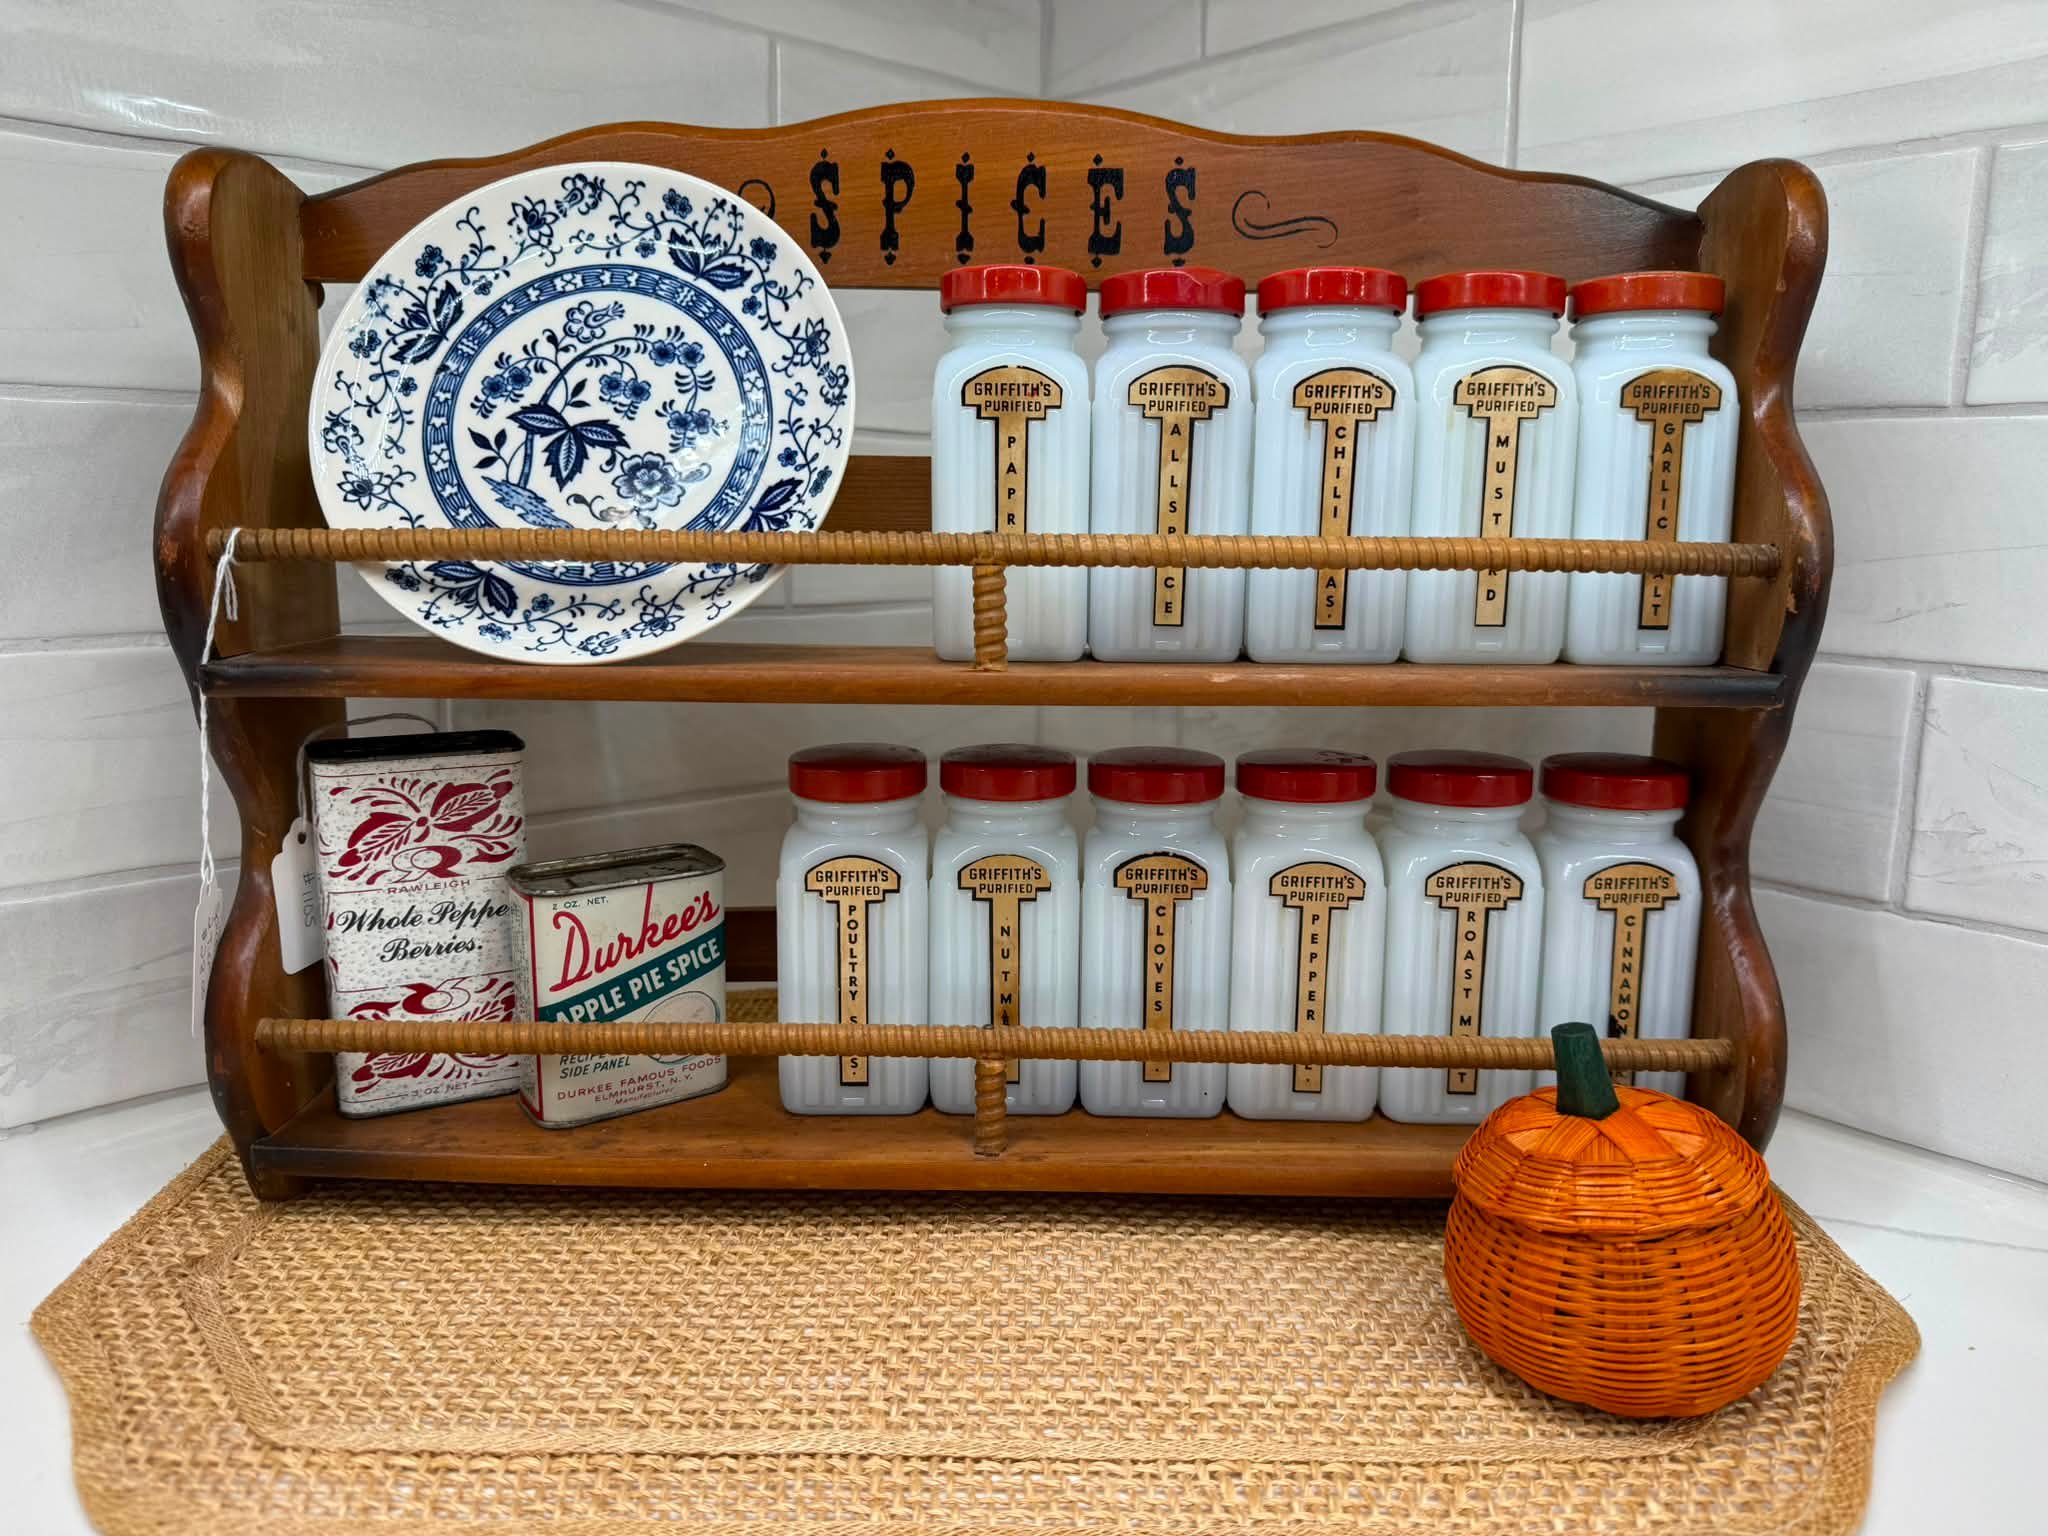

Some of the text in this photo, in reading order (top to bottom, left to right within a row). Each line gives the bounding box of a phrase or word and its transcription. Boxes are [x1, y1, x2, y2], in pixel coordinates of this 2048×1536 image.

[808, 147, 1197, 267] SPICES
[973, 381, 1052, 397] GRIFFITH'S
[1138, 381, 1217, 397] GRIFFITH'S
[1304, 383, 1384, 399] GRIFFITH'S
[1466, 380, 1546, 397] GRIFFITH'S
[1632, 383, 1711, 400] GRIFFITH'S
[984, 400, 1042, 412] PURIFIED
[1149, 400, 1206, 412] PURIFIED
[1313, 402, 1373, 415] PURIFIED
[1475, 400, 1536, 412] PURIFIED
[1641, 402, 1700, 414] PURIFIED
[1332, 426, 1347, 519] CHILI
[1656, 423, 1675, 529] GARLIC
[1005, 436, 1017, 526] PAPR
[1162, 423, 1182, 614] ALLSPCE
[1485, 435, 1510, 601] MUSTD
[815, 868, 889, 883] GRIFFITH'S
[968, 866, 1042, 881] GRIFFITH'S
[1125, 866, 1199, 881] GRIFFITH'S
[386, 879, 471, 895] RAWLEIGH
[825, 885, 881, 896] PURIFIED
[978, 883, 1033, 894] PURIFIED
[1134, 883, 1189, 894] PURIFIED
[1280, 875, 1356, 890] GRIFFITH'S
[1435, 875, 1512, 890] GRIFFITH'S
[1593, 875, 1671, 890] GRIFFITH'S
[1289, 891, 1345, 903] PURIFIED
[1444, 891, 1501, 903] PURIFIED
[1602, 892, 1660, 904] PURIFIED
[335, 898, 511, 934] Whole Peppe
[548, 883, 720, 993] Durkee's
[379, 935, 484, 963] Berries.
[846, 904, 859, 1001] POULTRY
[1462, 911, 1477, 999] ROAST
[1153, 904, 1167, 1012] CLOVES
[628, 967, 665, 1001] PIE
[665, 937, 721, 983] SPICE
[1304, 913, 1320, 1021] PEPPER
[1616, 915, 1636, 1036] CINNAMON
[559, 1055, 631, 1080] SIDE PANEL
[557, 1056, 721, 1101] DURKEE FAMOUS FOODS
